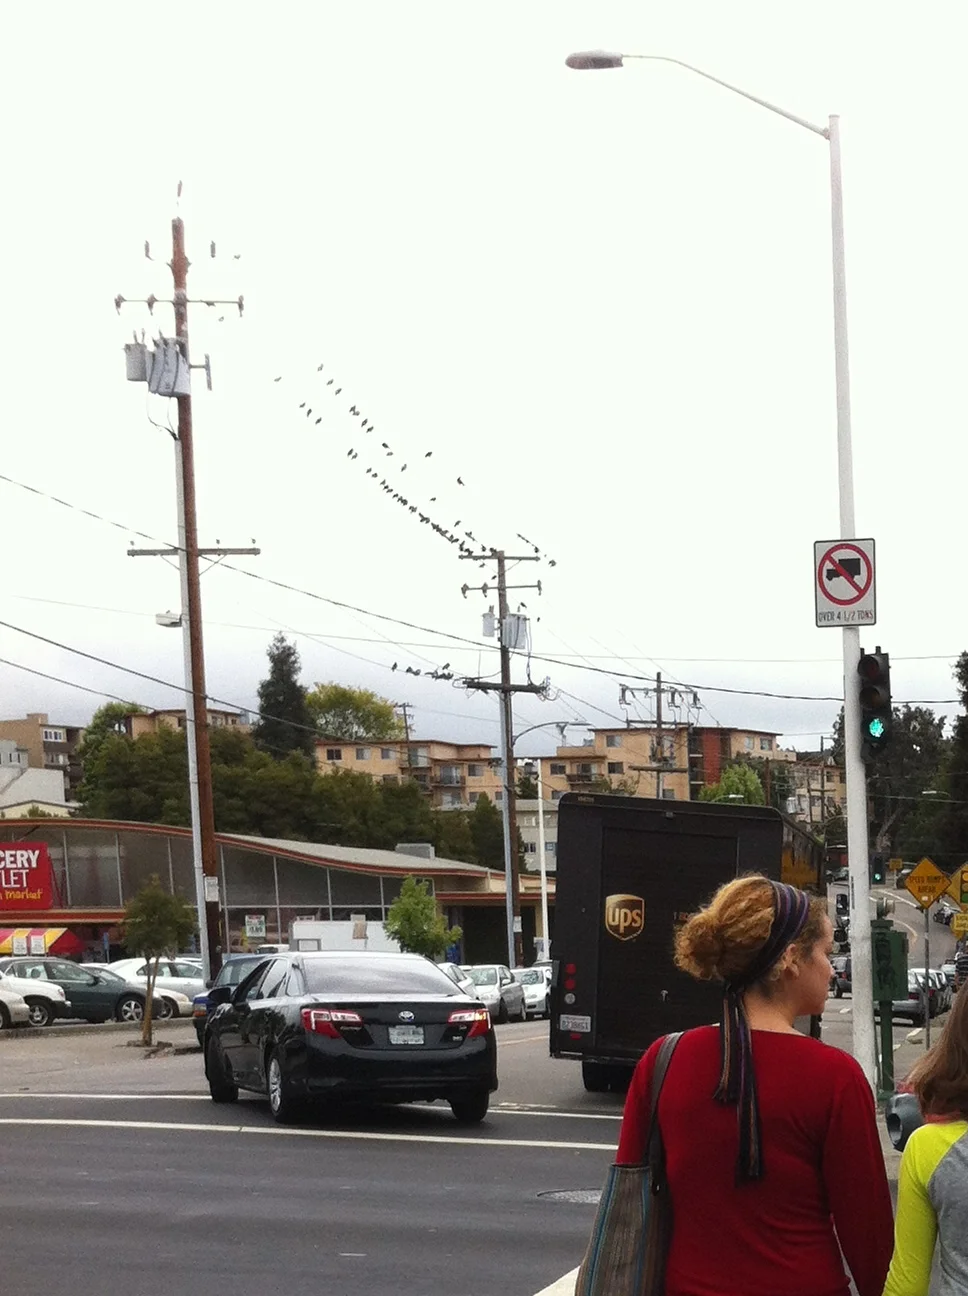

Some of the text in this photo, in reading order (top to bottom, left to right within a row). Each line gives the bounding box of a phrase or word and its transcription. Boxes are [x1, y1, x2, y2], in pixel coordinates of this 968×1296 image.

[818, 610, 835, 622] OVER
[836, 610, 842, 621] 4
[857, 609, 874, 620] TONS
[0, 869, 29, 888] LET
[5, 887, 43, 900] market
[608, 907, 642, 934] ups
